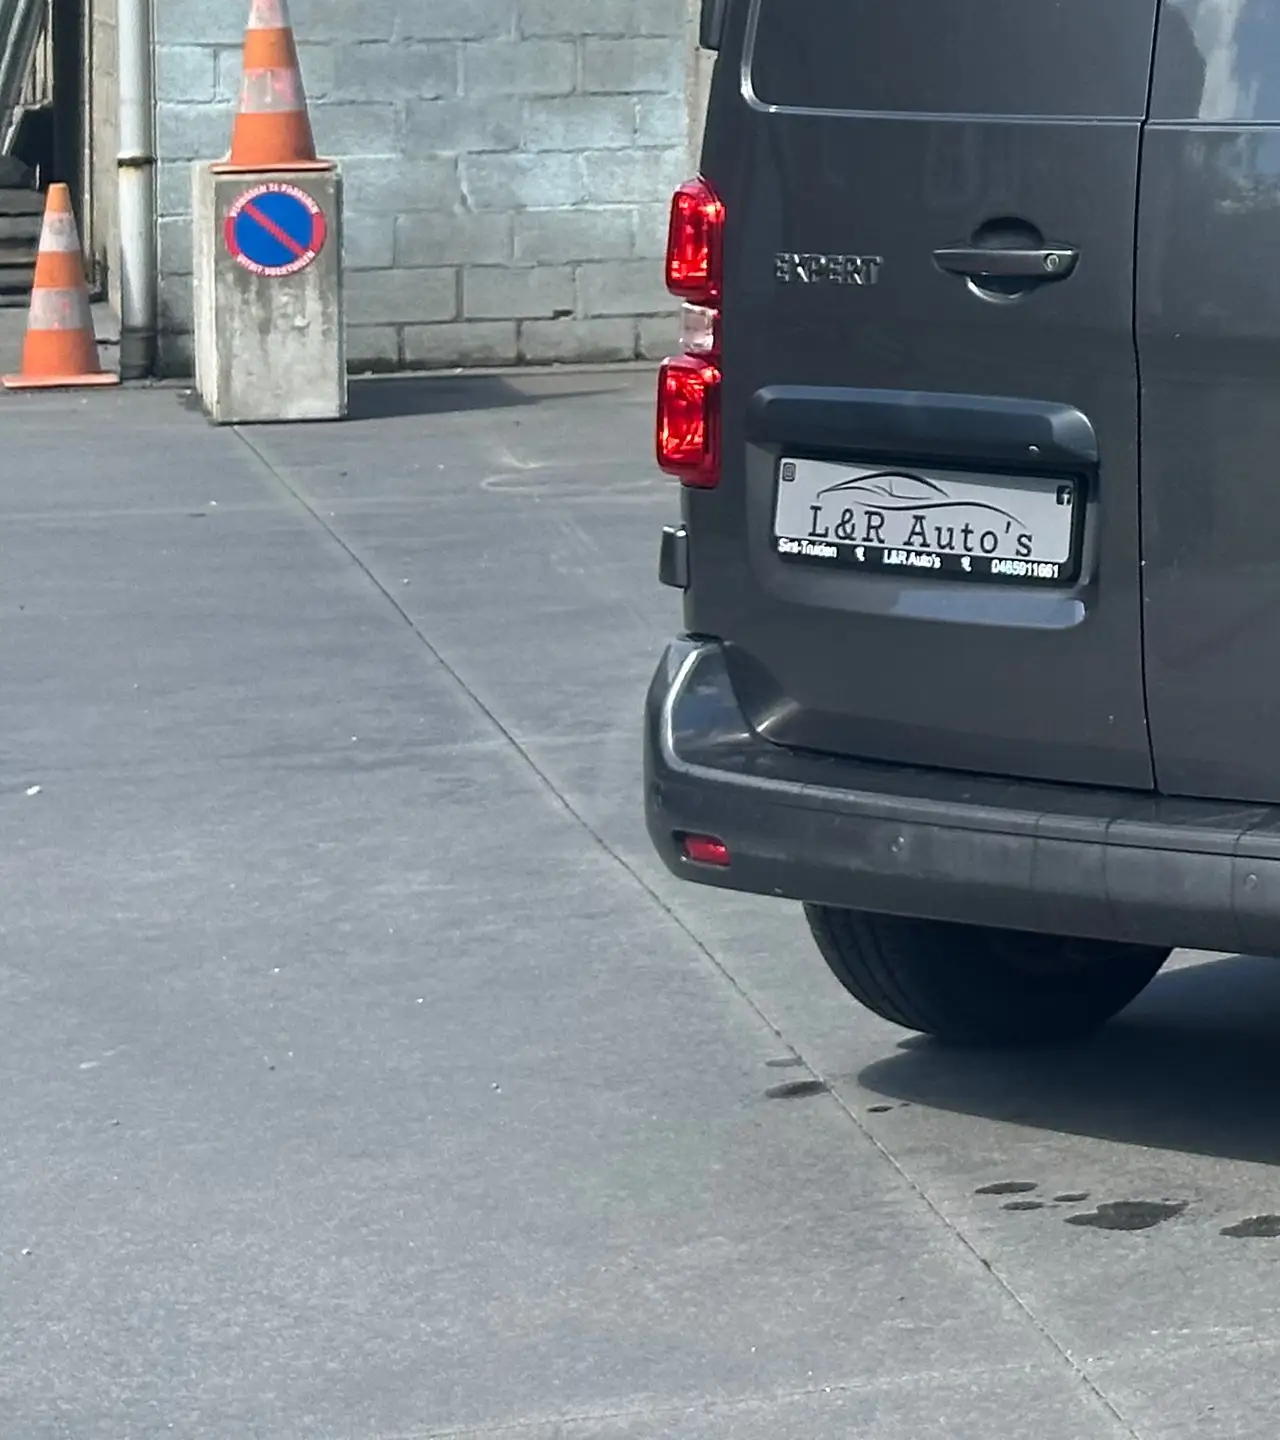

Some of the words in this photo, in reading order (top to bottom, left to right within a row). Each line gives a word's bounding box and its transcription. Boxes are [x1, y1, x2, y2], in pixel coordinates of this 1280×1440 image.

[774, 252, 883, 284] EXPERT
[807, 505, 885, 544] L&R
[903, 514, 1033, 557] Auto's
